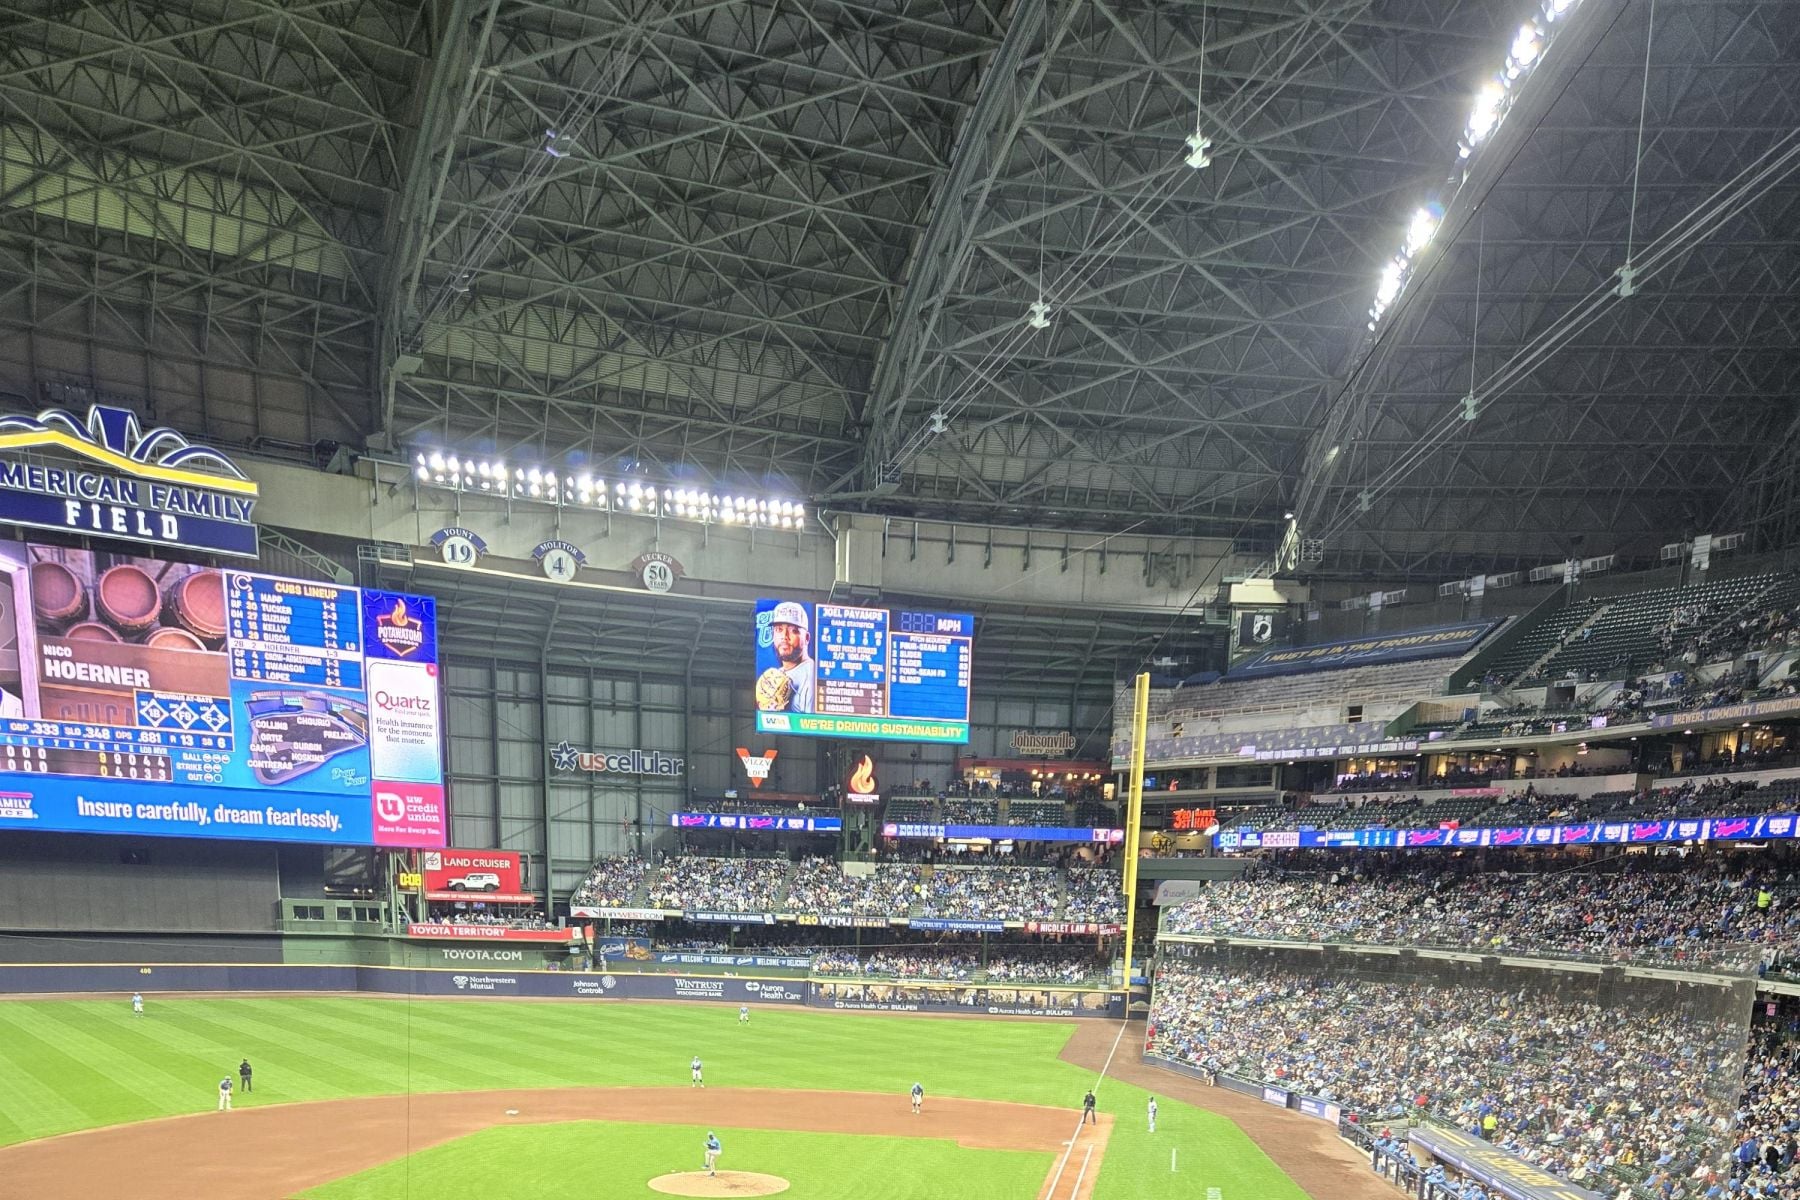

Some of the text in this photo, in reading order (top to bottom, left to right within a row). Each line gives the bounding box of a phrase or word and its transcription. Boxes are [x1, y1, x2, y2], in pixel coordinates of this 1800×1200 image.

[0, 462, 256, 524] MERICAN FAMILY
[65, 500, 179, 541] FIELD
[443, 528, 474, 541] YOUNT
[448, 543, 475, 564] 19
[540, 542, 579, 556] MOLITOR
[641, 552, 673, 565] UECKER
[553, 556, 566, 576] 4
[649, 565, 667, 580] 50
[274, 582, 338, 600] CUBS LINEUP
[261, 603, 293, 615] TUCKER
[822, 607, 883, 622] JOEL PAYAMPS
[262, 623, 287, 633] KELLY
[937, 618, 962, 633] MPH
[377, 626, 423, 644] POTAWATOMI
[43, 644, 73, 658] NICO
[264, 642, 300, 653] HOERNER
[1268, 651, 1308, 662] MUST
[1306, 648, 1329, 658] BE
[1329, 645, 1347, 655] IN
[1347, 641, 1378, 652] THE
[1375, 634, 1432, 648] FRONT
[1428, 628, 1478, 642] ROW!
[265, 661, 306, 673] SWANSON
[44, 659, 151, 689] HOERNER
[375, 690, 431, 712] Quartz
[1672, 711, 1705, 726] BREWERS
[1707, 705, 1753, 720] COMMUNITY
[255, 720, 289, 731] COLLINS
[297, 717, 331, 728] CHOURIO
[376, 717, 434, 730] Health insurance
[799, 718, 965, 738] WE'RE DRIVING SUSTAINABILITY
[30, 723, 60, 736] .333
[82, 726, 111, 740] .348
[137, 731, 162, 743] .681
[180, 734, 194, 746] 13
[260, 732, 283, 743] ORTIZ
[323, 730, 354, 741] FRELICK
[377, 725, 433, 738] for the moments
[386, 734, 426, 745] that matter.
[1009, 729, 1077, 750] Johnsonville
[250, 743, 278, 754] CAPRA
[6, 745, 16, 758] 0
[22, 746, 31, 759] 0
[38, 747, 47, 760] 0
[128, 754, 137, 766] 0
[182, 752, 202, 761] BALL
[291, 752, 325, 763] HOSKINS
[7, 758, 17, 771] 0
[23, 759, 32, 772] 0
[39, 760, 48, 773] 0
[100, 765, 108, 777] 0
[115, 766, 123, 778] 4
[130, 766, 138, 778] 0
[176, 762, 203, 771] STRIKE
[247, 759, 294, 770] CONTRERAS
[187, 773, 205, 783] OUT
[406, 795, 423, 804] uw
[77, 795, 343, 833] Insure carefully, dream fearlessly.
[406, 803, 439, 814] credit
[407, 812, 440, 823] union
[444, 857, 511, 869] LAND CRUISER
[797, 914, 819, 926] 620
[820, 915, 852, 927] WTMJ
[910, 920, 944, 929] WINTRUST
[947, 921, 986, 930] WISCONSIN'S
[411, 926, 506, 937] TOYOTA TERRITORY
[1040, 923, 1087, 934] NICOLET LAW
[442, 949, 522, 962] TOYOTA.COM
[680, 955, 704, 963] WELCOME
[756, 958, 780, 966] WELCOME
[786, 959, 811, 967] DELICIOUS
[469, 976, 517, 985] Northwestern
[573, 980, 599, 989] Johnson
[674, 978, 725, 990] WINTRUST
[577, 987, 604, 995] Controls
[760, 983, 785, 992] Aurora
[760, 991, 802, 1000] Health Care
[844, 1002, 862, 1010] Aurora
[862, 1002, 879, 1010] Health
[878, 1003, 889, 1011] Care
[1016, 1008, 1031, 1016] Health
[1045, 1009, 1073, 1017] BULLPEN
